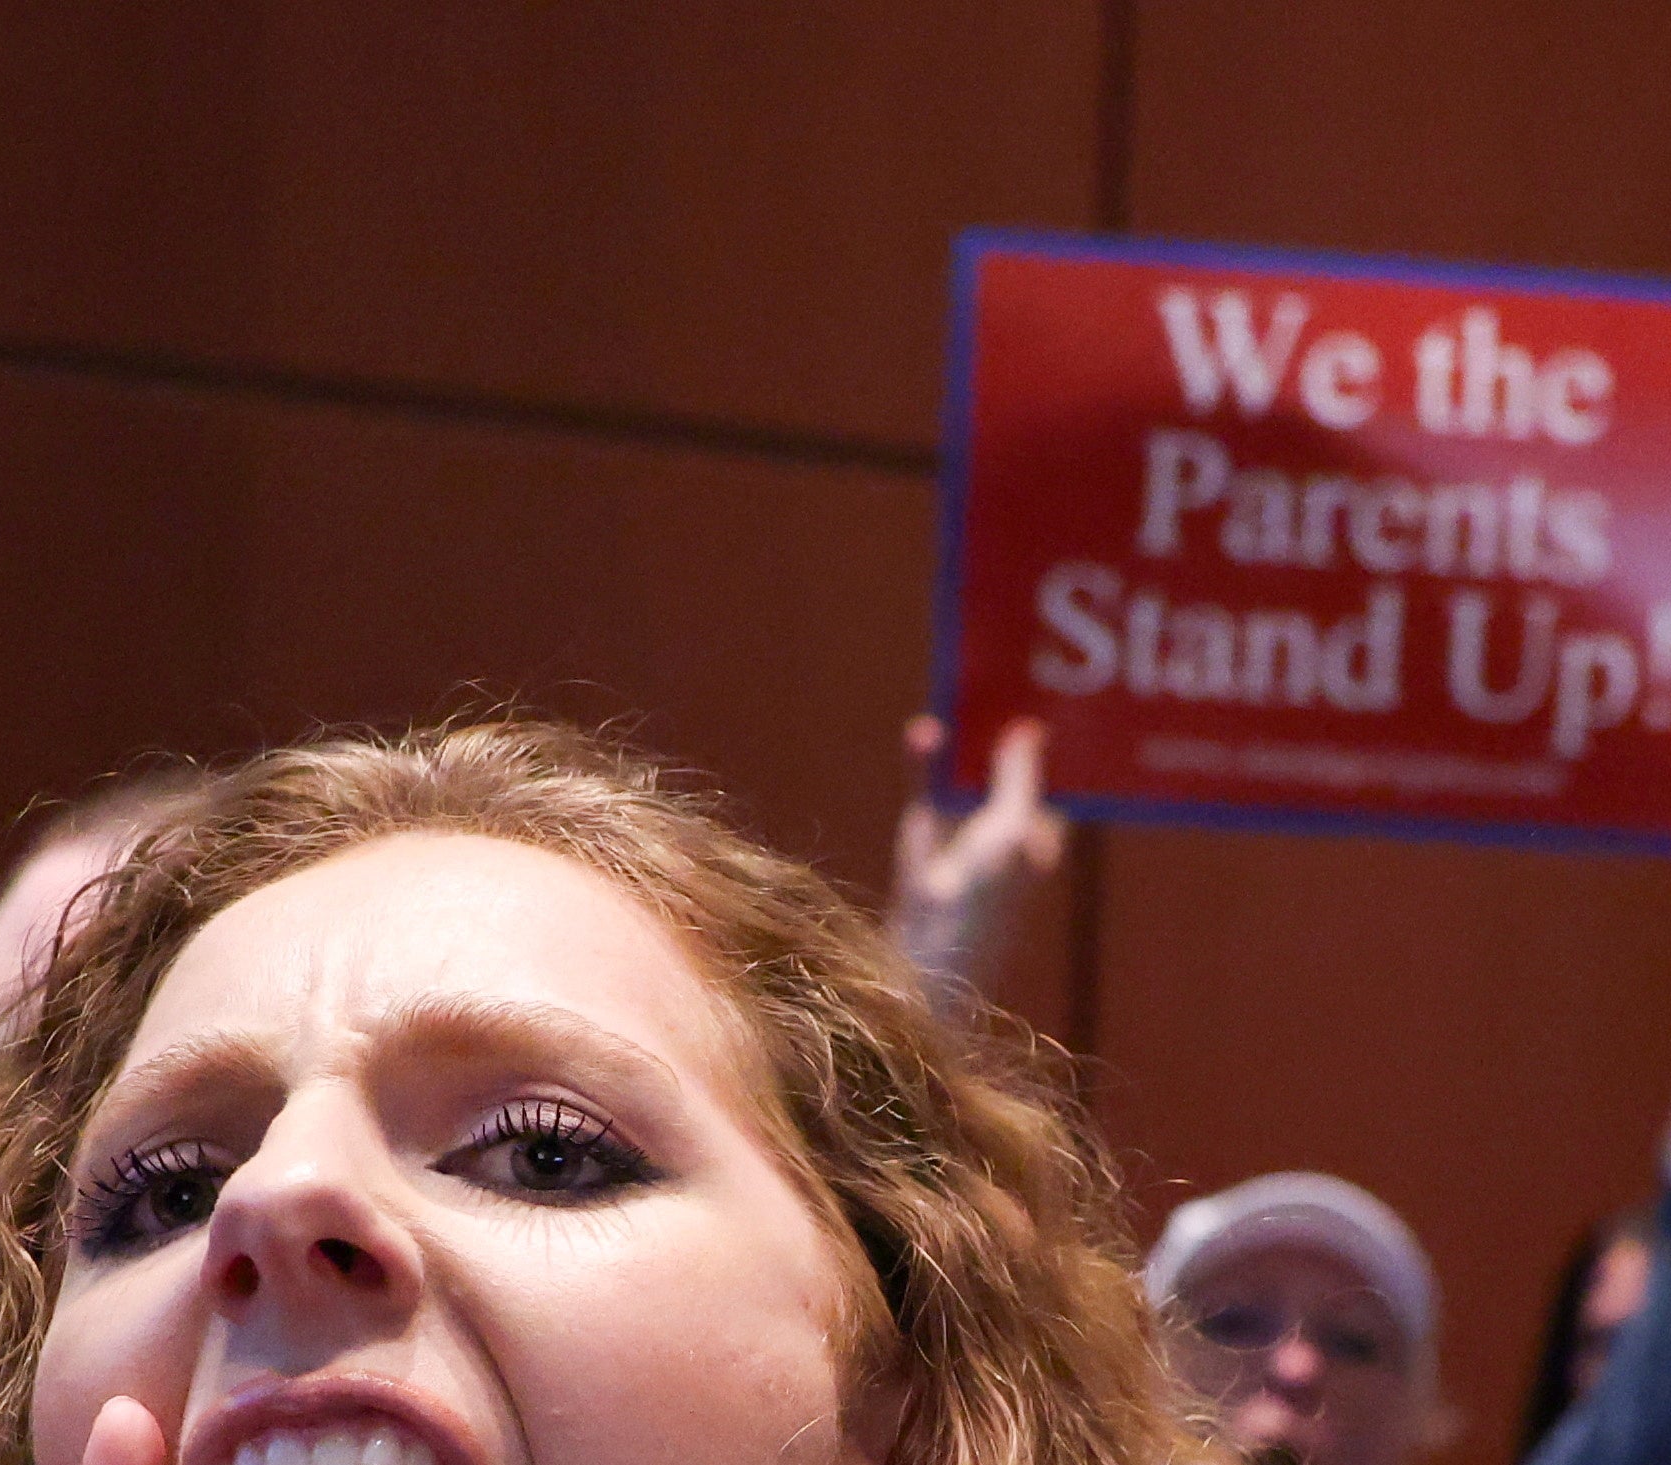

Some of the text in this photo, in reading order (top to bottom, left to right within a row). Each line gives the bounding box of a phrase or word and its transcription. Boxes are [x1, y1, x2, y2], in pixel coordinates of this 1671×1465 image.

[1159, 285, 1616, 447] We the
[1137, 428, 1613, 585] Parents
[1026, 560, 1404, 713] Stand
